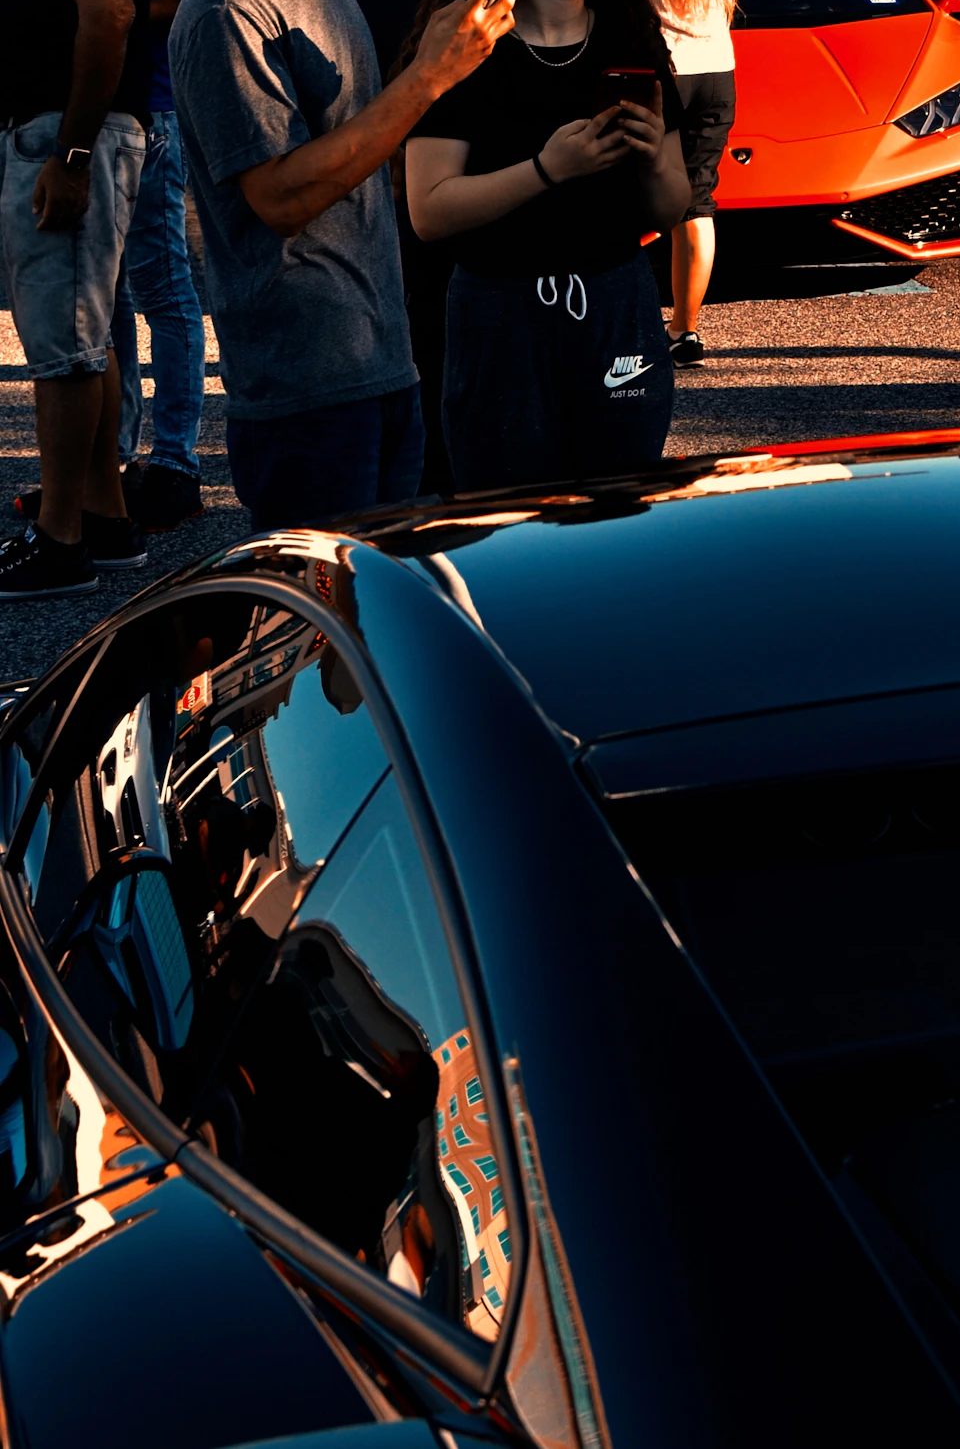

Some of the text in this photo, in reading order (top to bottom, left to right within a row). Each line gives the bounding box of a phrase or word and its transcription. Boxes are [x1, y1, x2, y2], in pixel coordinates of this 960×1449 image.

[611, 355, 644, 374] NIKE
[610, 389, 626, 399] JUST
[627, 389, 639, 398] DO
